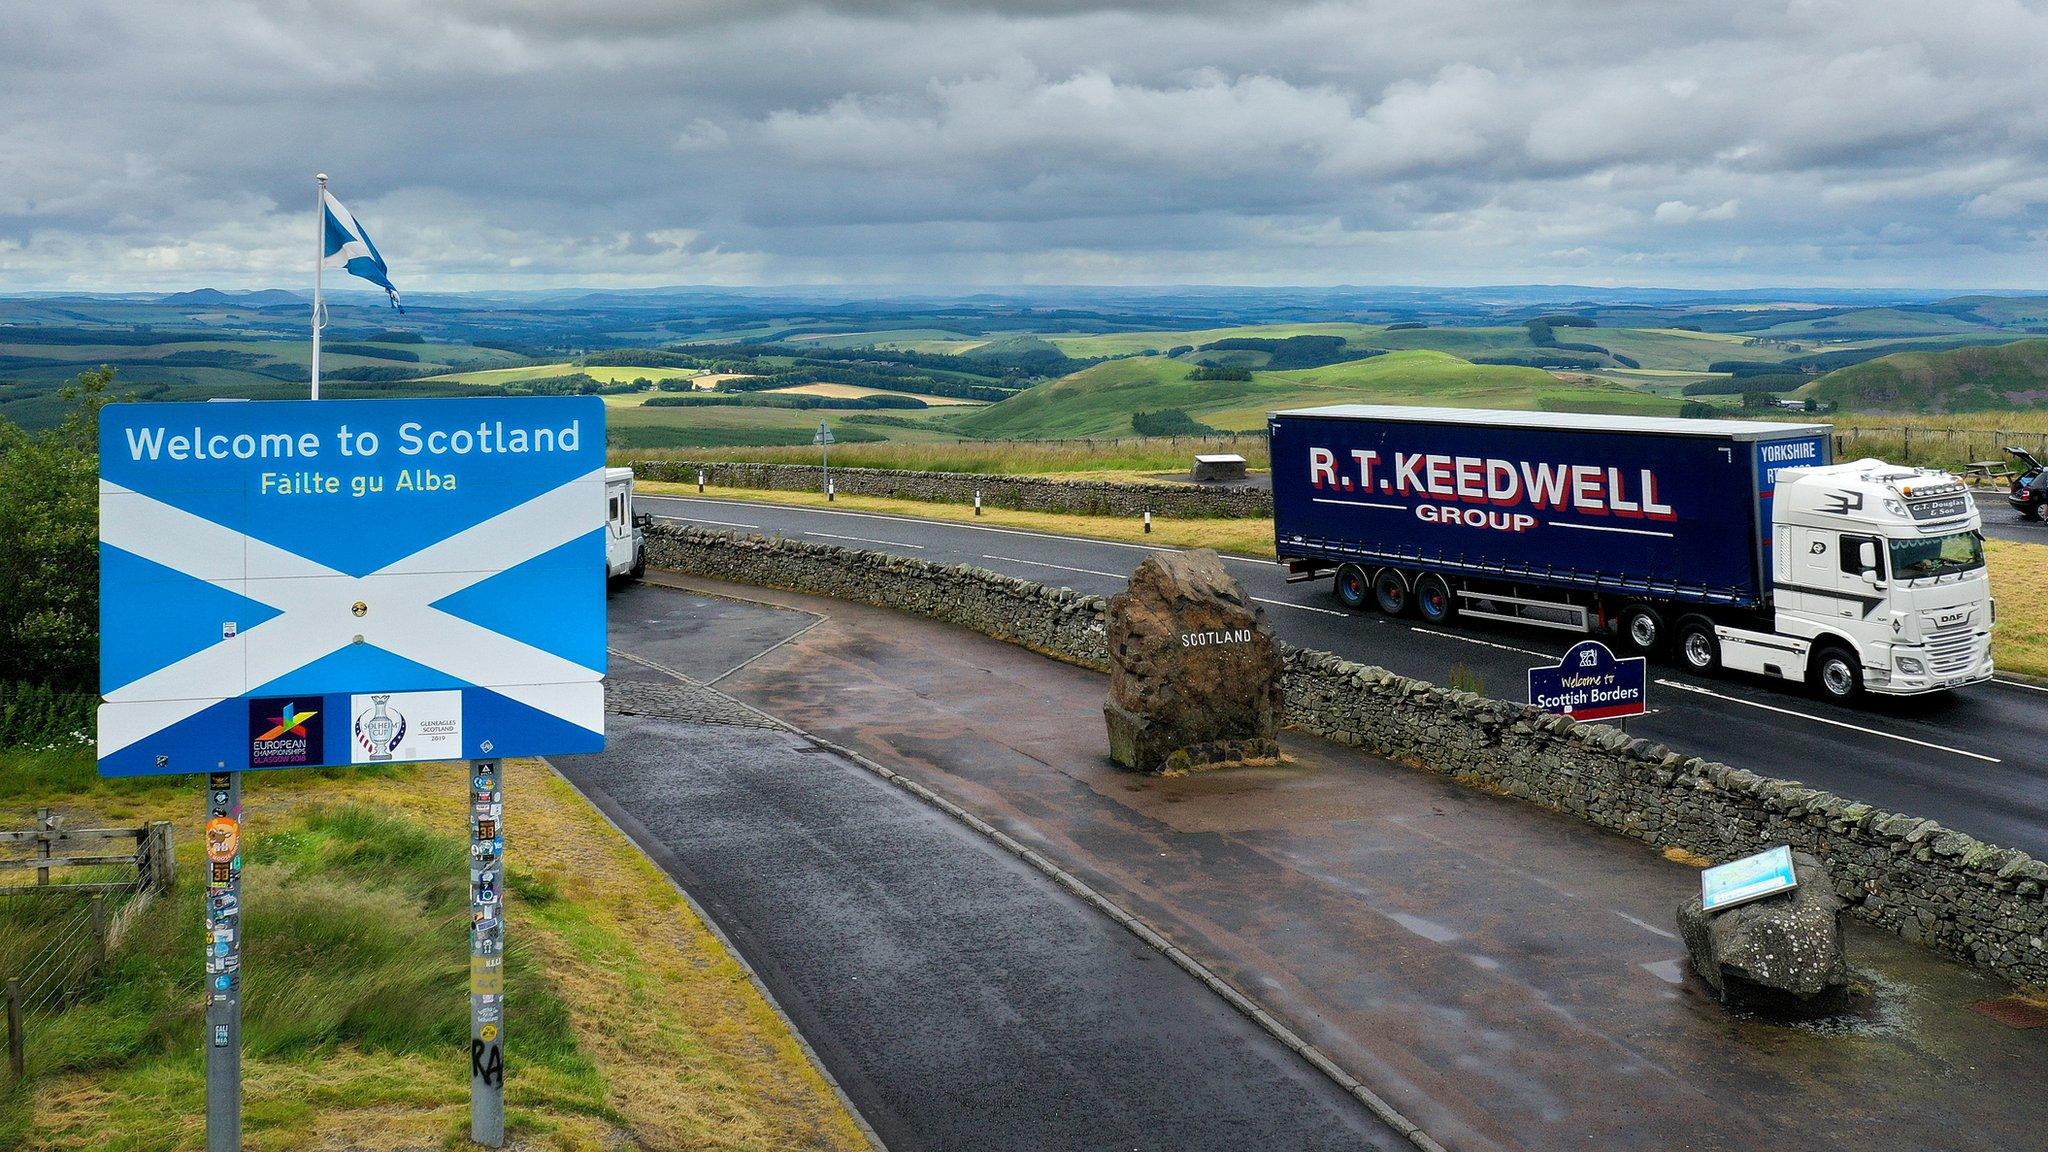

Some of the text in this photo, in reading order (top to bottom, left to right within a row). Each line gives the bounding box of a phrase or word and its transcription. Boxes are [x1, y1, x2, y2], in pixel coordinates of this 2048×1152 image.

[125, 420, 580, 460] Welcome to Scotland
[1761, 442, 1816, 462] YORKSHIRE
[261, 469, 457, 497] Fàilte gu Alba
[1932, 500, 1964, 509] Douglas
[1415, 504, 1537, 532] GROUP
[1941, 613, 1963, 622] DAF
[1181, 629, 1251, 647] SCOTLAND
[1561, 672, 1614, 688] Welcome to
[1537, 686, 1638, 708] Scottish Borders
[253, 740, 306, 750] EUROPEAN
[253, 748, 306, 757] CHAMPIONSHIPS
[472, 1038, 503, 1089] RA
